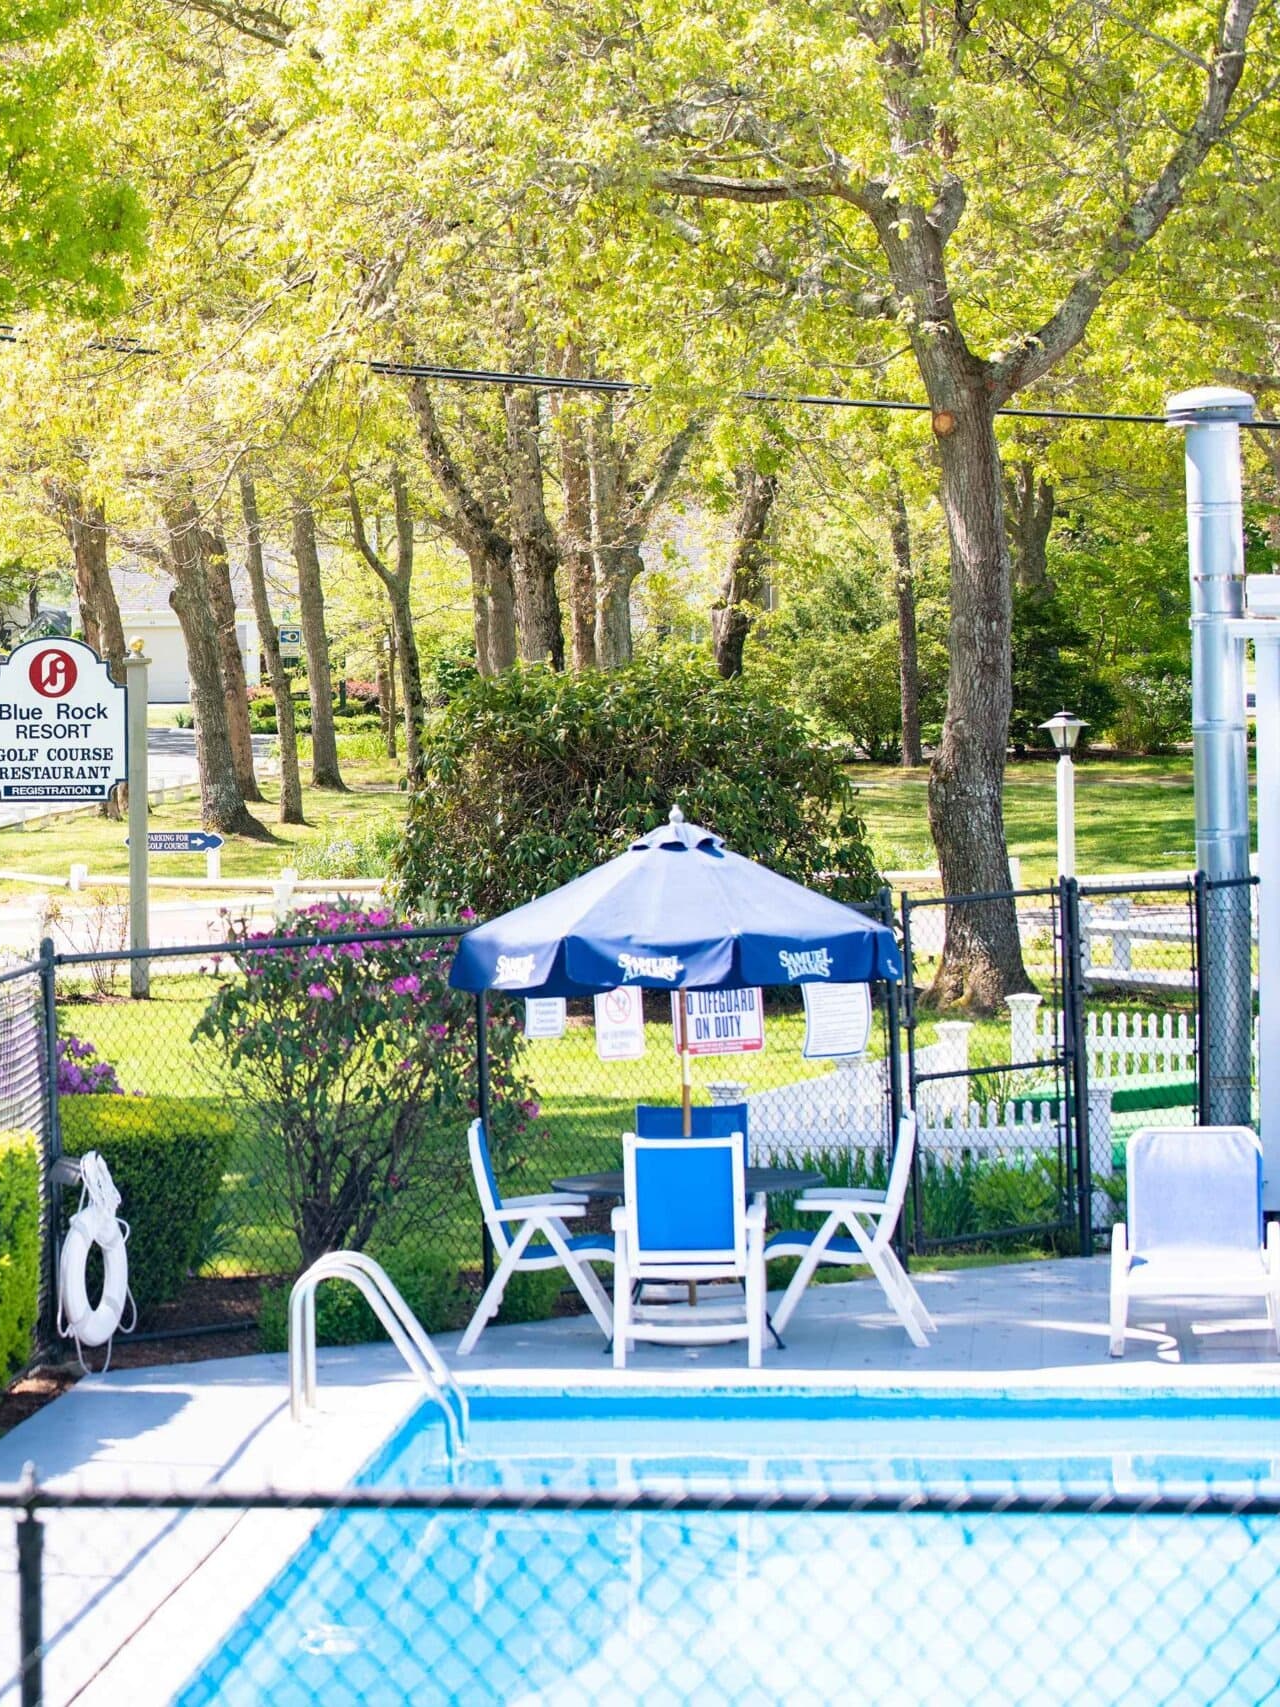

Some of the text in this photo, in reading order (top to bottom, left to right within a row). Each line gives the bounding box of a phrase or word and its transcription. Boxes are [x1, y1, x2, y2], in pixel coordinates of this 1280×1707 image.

[57, 703, 108, 720] Rock
[16, 724, 92, 740] RESORT
[47, 748, 113, 762] COURSE
[11, 786, 91, 795] REGISTRATION
[149, 842, 189, 850] OLF COURSE
[176, 834, 189, 842] FOR
[618, 953, 684, 971] SAMUEL
[778, 947, 833, 967] SAMUEL
[787, 960, 831, 981] ADAMS
[698, 989, 755, 1015] LIFEGUARD
[695, 1015, 741, 1040] ON DUTY
